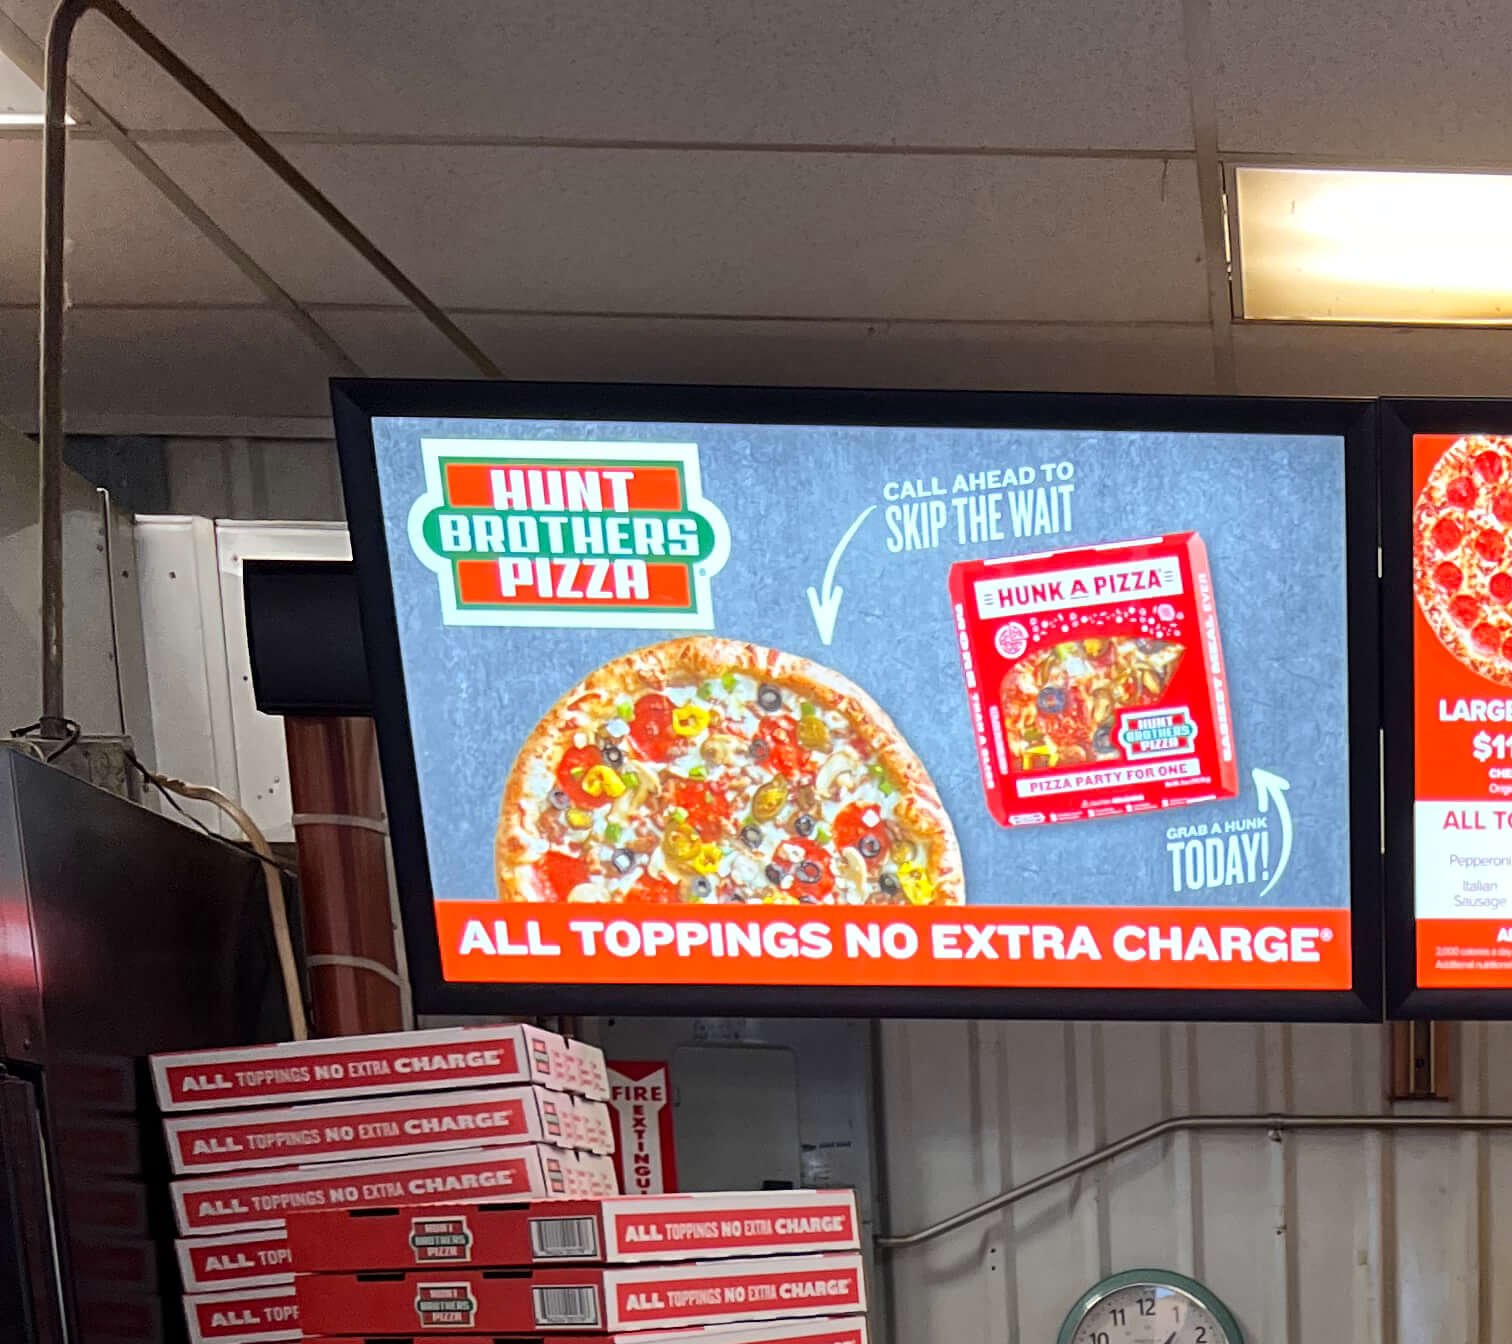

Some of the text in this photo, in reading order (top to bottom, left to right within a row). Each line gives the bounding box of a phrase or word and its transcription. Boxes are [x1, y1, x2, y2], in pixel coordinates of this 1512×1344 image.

[490, 468, 634, 512] HUNT
[883, 462, 1074, 501] CALL AHEAD TO
[438, 514, 698, 556] BROTHERS
[886, 485, 1074, 553] SKIP THE WAIT
[500, 558, 648, 600] PIZZA
[998, 569, 1162, 608] HUNK A PIZZA
[1030, 763, 1188, 792] PIZZA PARTY FOR ONE
[1167, 818, 1267, 839] GRAB A HUNK
[1443, 811, 1486, 830] ALL
[1167, 832, 1269, 892] TODAY!
[1449, 854, 1511, 869] Pepperoni
[459, 920, 560, 955] ALL
[570, 921, 832, 958] TOPPINGS
[845, 924, 919, 959] NO
[932, 925, 1101, 961] EXTRA
[181, 1072, 232, 1092] ALL
[238, 1065, 310, 1088] TOPPINGS
[314, 1062, 344, 1081] NO
[349, 1059, 390, 1078] EXTRA
[612, 1086, 662, 1101] FIRE
[632, 1105, 651, 1194] EXTINGU
[1136, 1298, 1156, 1316] 12
